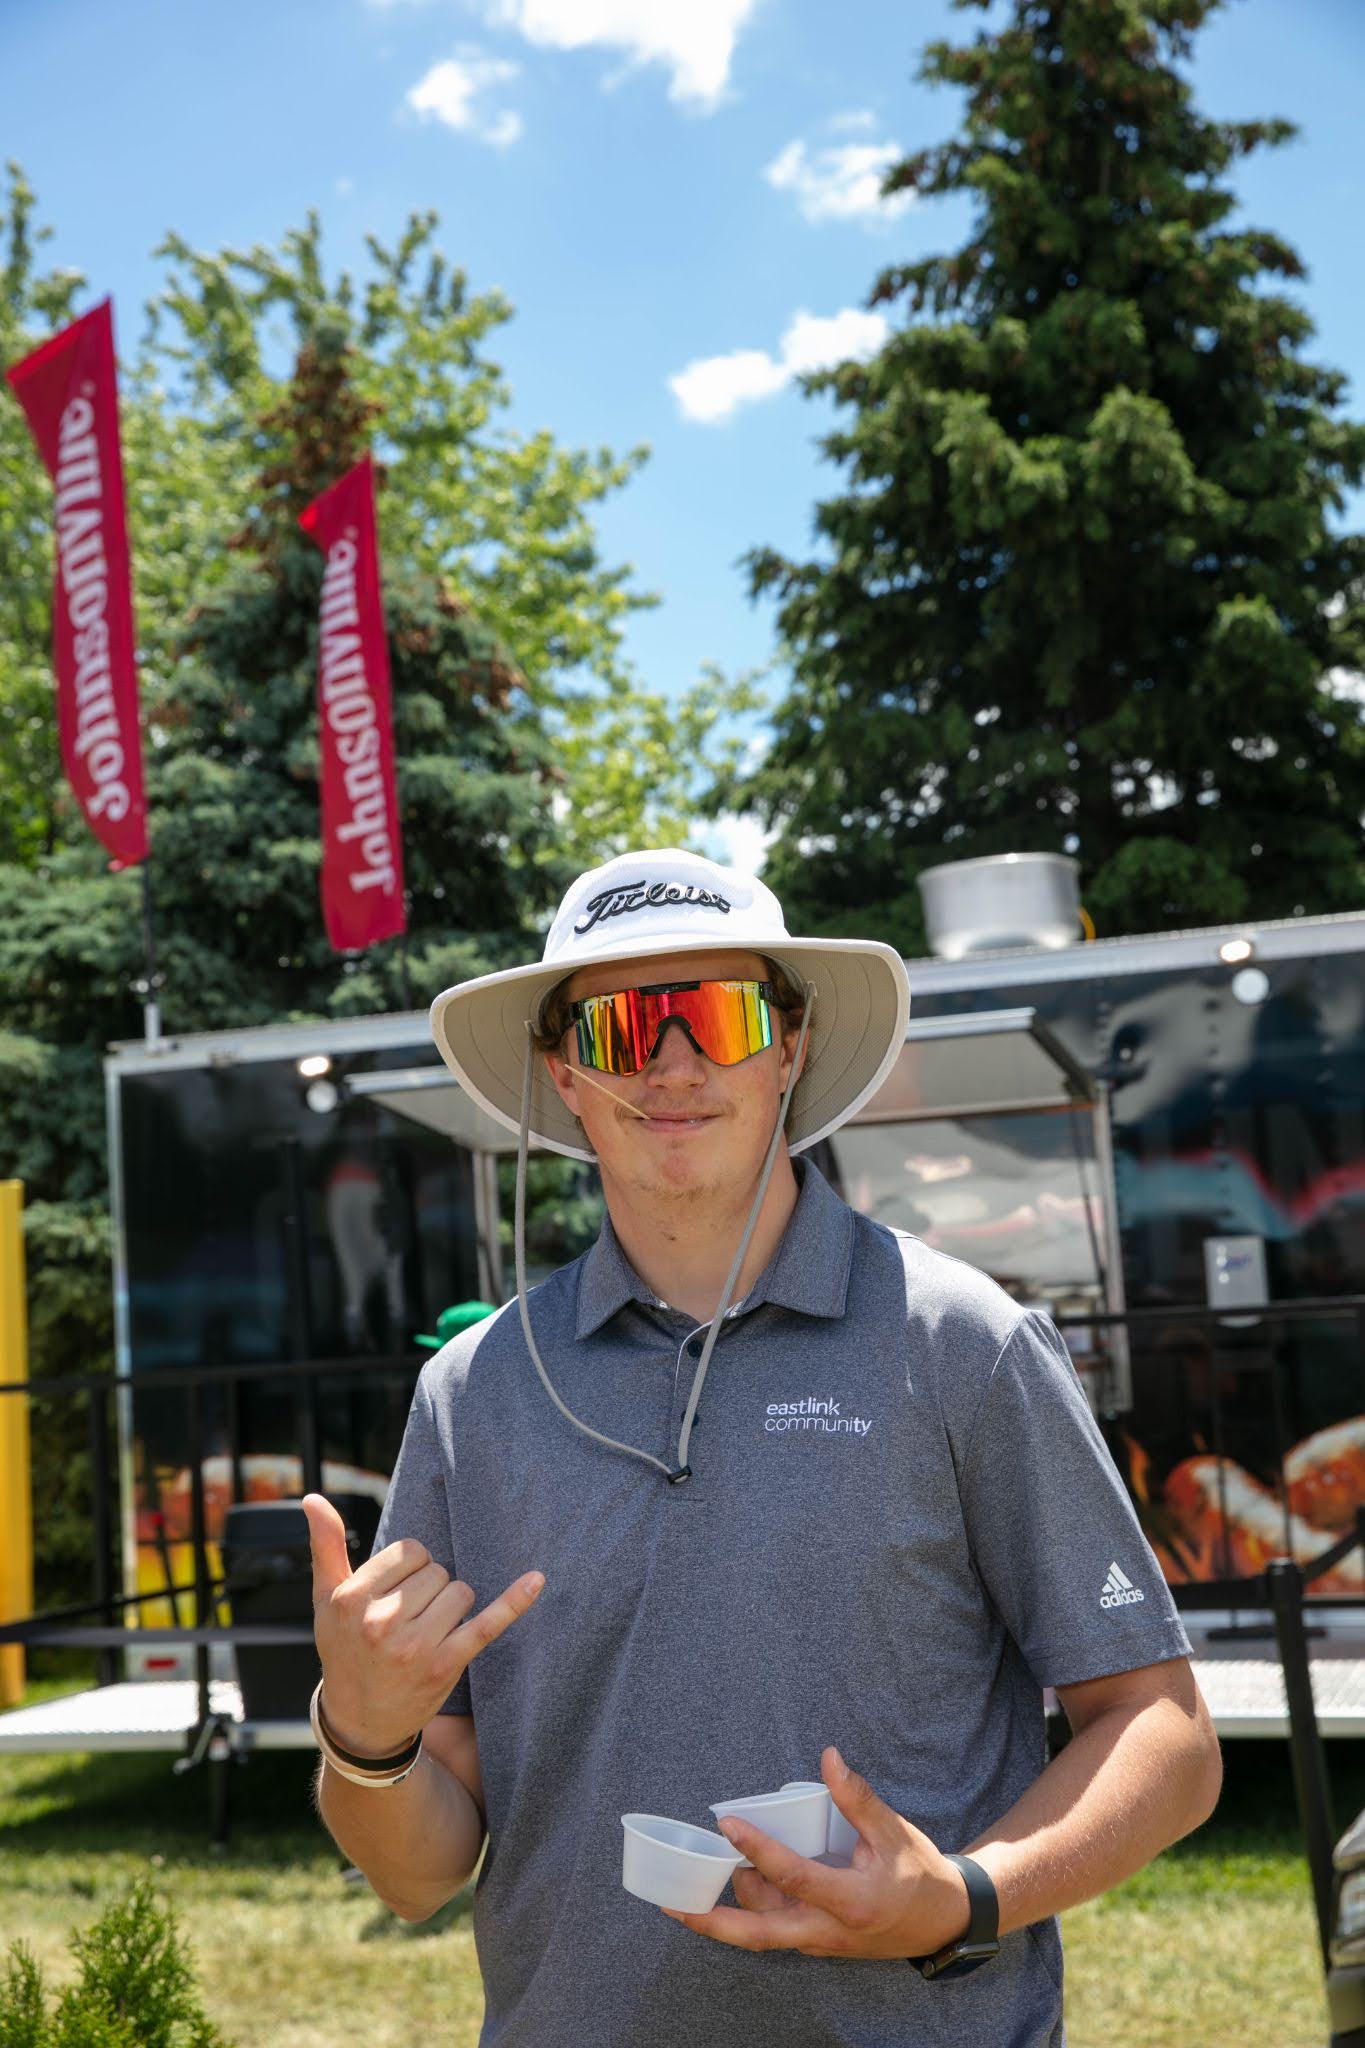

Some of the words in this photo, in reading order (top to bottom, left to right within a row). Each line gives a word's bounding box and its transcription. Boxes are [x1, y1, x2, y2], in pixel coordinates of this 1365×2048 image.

[573, 879, 731, 935] Titleist
[766, 1396, 841, 1416] eastlink
[764, 1416, 872, 1437] community
[1100, 1588, 1145, 1609] adidas
